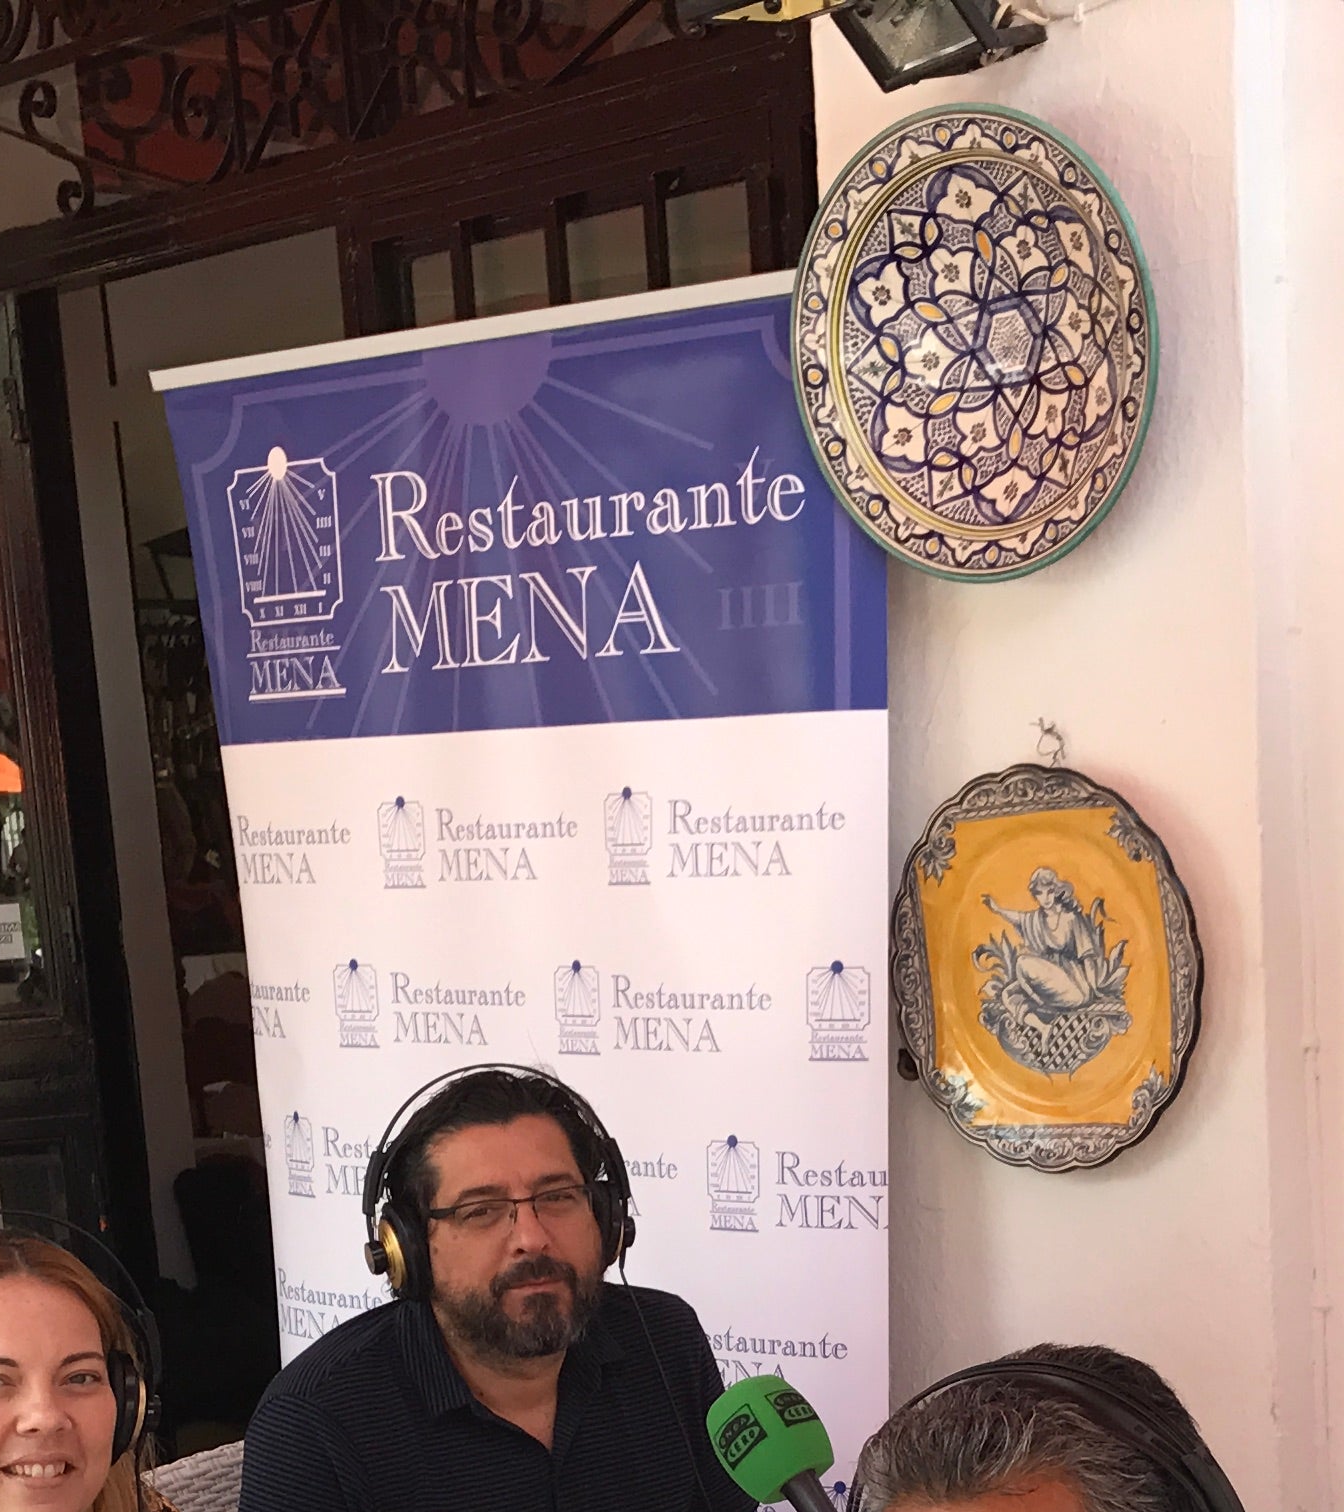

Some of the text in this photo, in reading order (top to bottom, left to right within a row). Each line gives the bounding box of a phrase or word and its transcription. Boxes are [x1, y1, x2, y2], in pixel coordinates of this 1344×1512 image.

[370, 445, 806, 563] Restaurante
[380, 560, 681, 675] MENA
[250, 628, 335, 652] Restaurante
[250, 654, 342, 694] MENA
[237, 814, 352, 847] Restaurante
[434, 807, 578, 842] Restaurante
[667, 799, 846, 836] Restaurante
[240, 852, 317, 885] MENA
[437, 847, 539, 883] MENA
[666, 840, 793, 879] MENA
[389, 971, 526, 1007] Restaurante
[611, 974, 772, 1011] Restaurante
[393, 1011, 488, 1046] MENA
[613, 1016, 722, 1053] MENA
[810, 1044, 866, 1059] MENA
[711, 1214, 757, 1230] MENA
[775, 1193, 888, 1231] MEN
[729, 1429, 756, 1458] CERO
